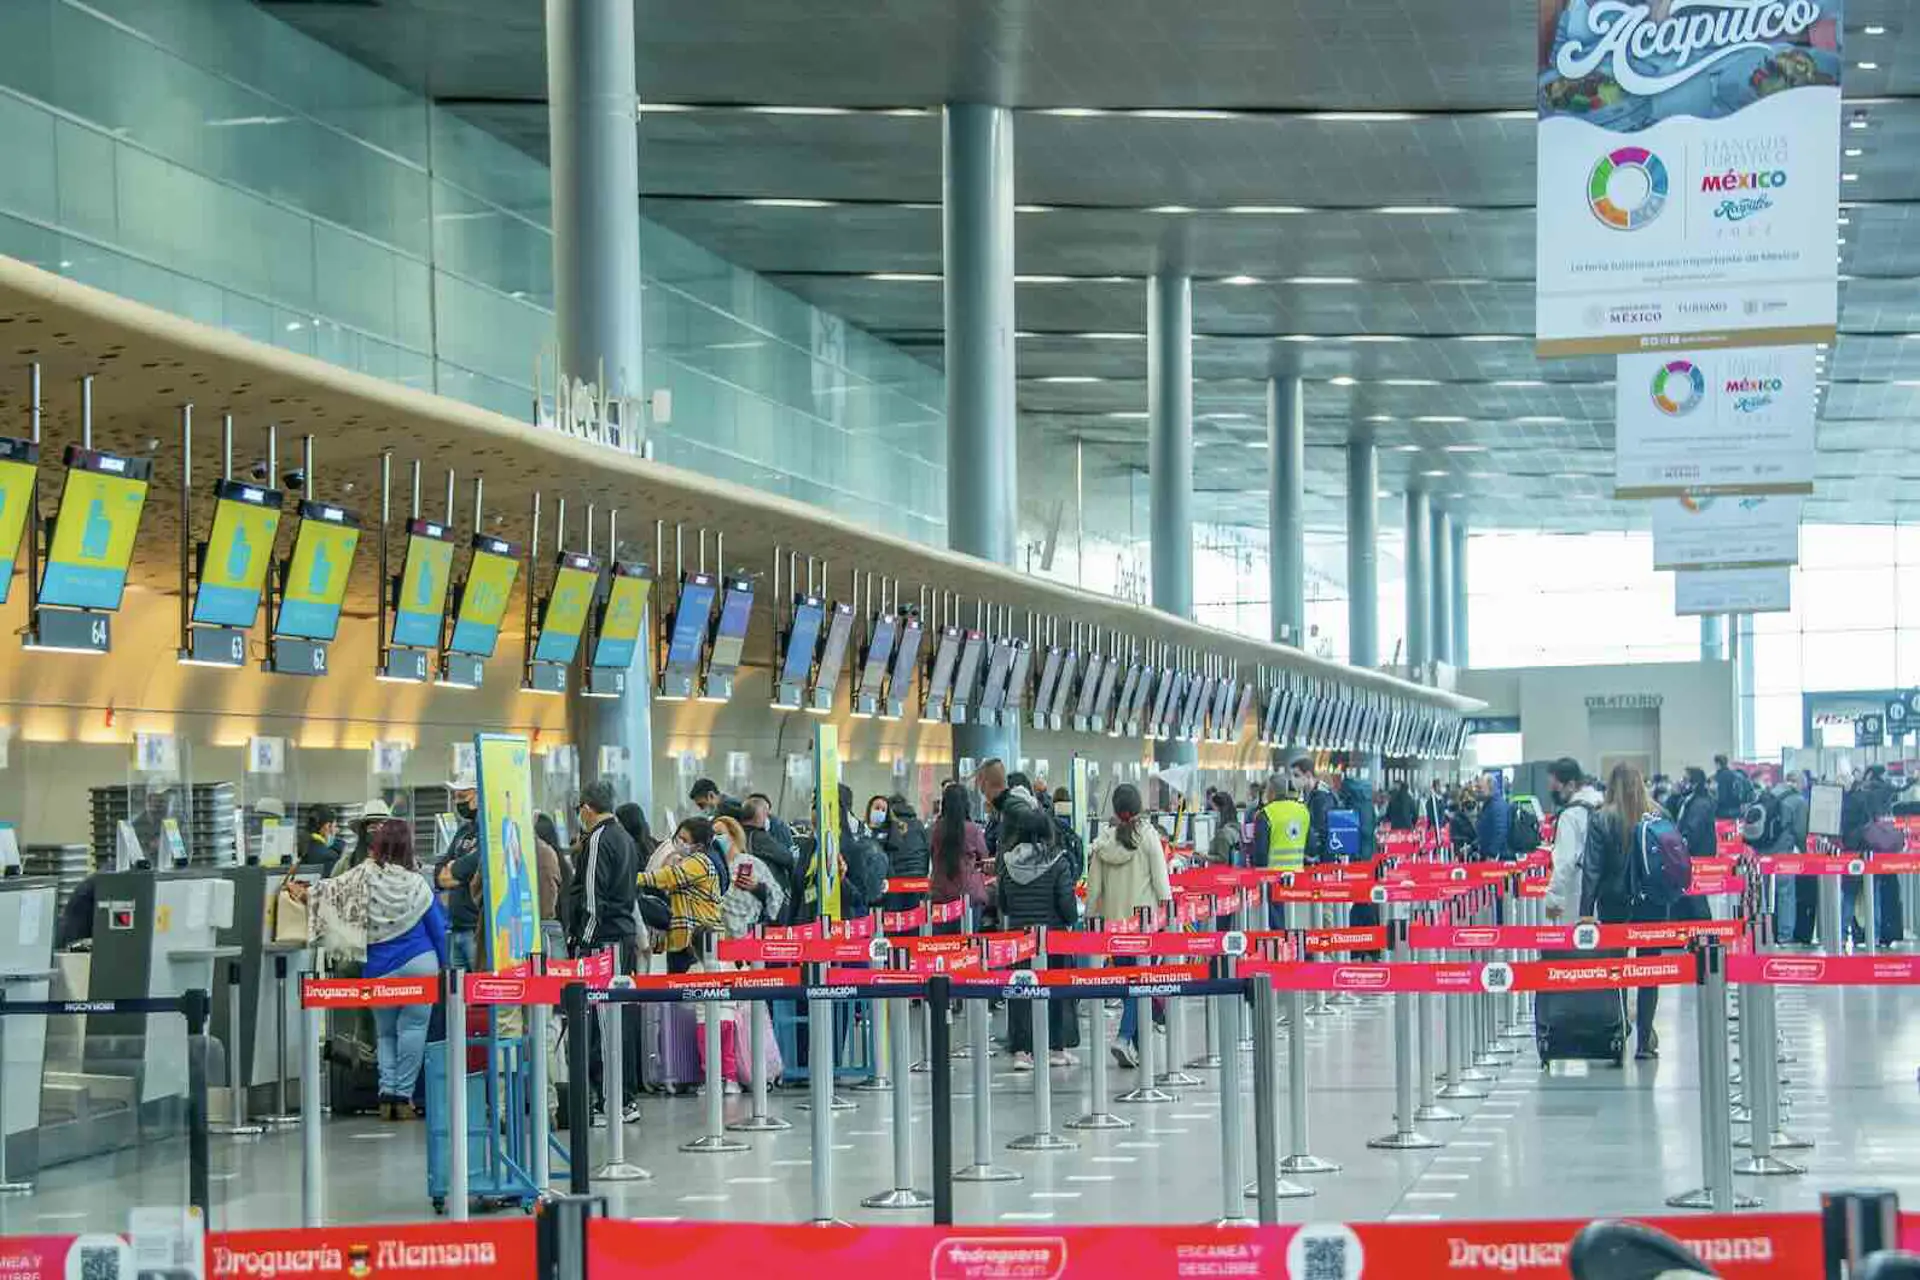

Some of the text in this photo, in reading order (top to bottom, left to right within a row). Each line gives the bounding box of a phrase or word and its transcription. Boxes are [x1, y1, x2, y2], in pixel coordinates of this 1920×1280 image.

[1557, 0, 1819, 95] Acapulco
[91, 620, 106, 646] 64
[231, 636, 243, 660] 63
[313, 647, 325, 670] 62
[1622, 964, 1679, 978] Alemana
[376, 1239, 497, 1271] Alemana
[1448, 1236, 1772, 1271] Droguer mana
